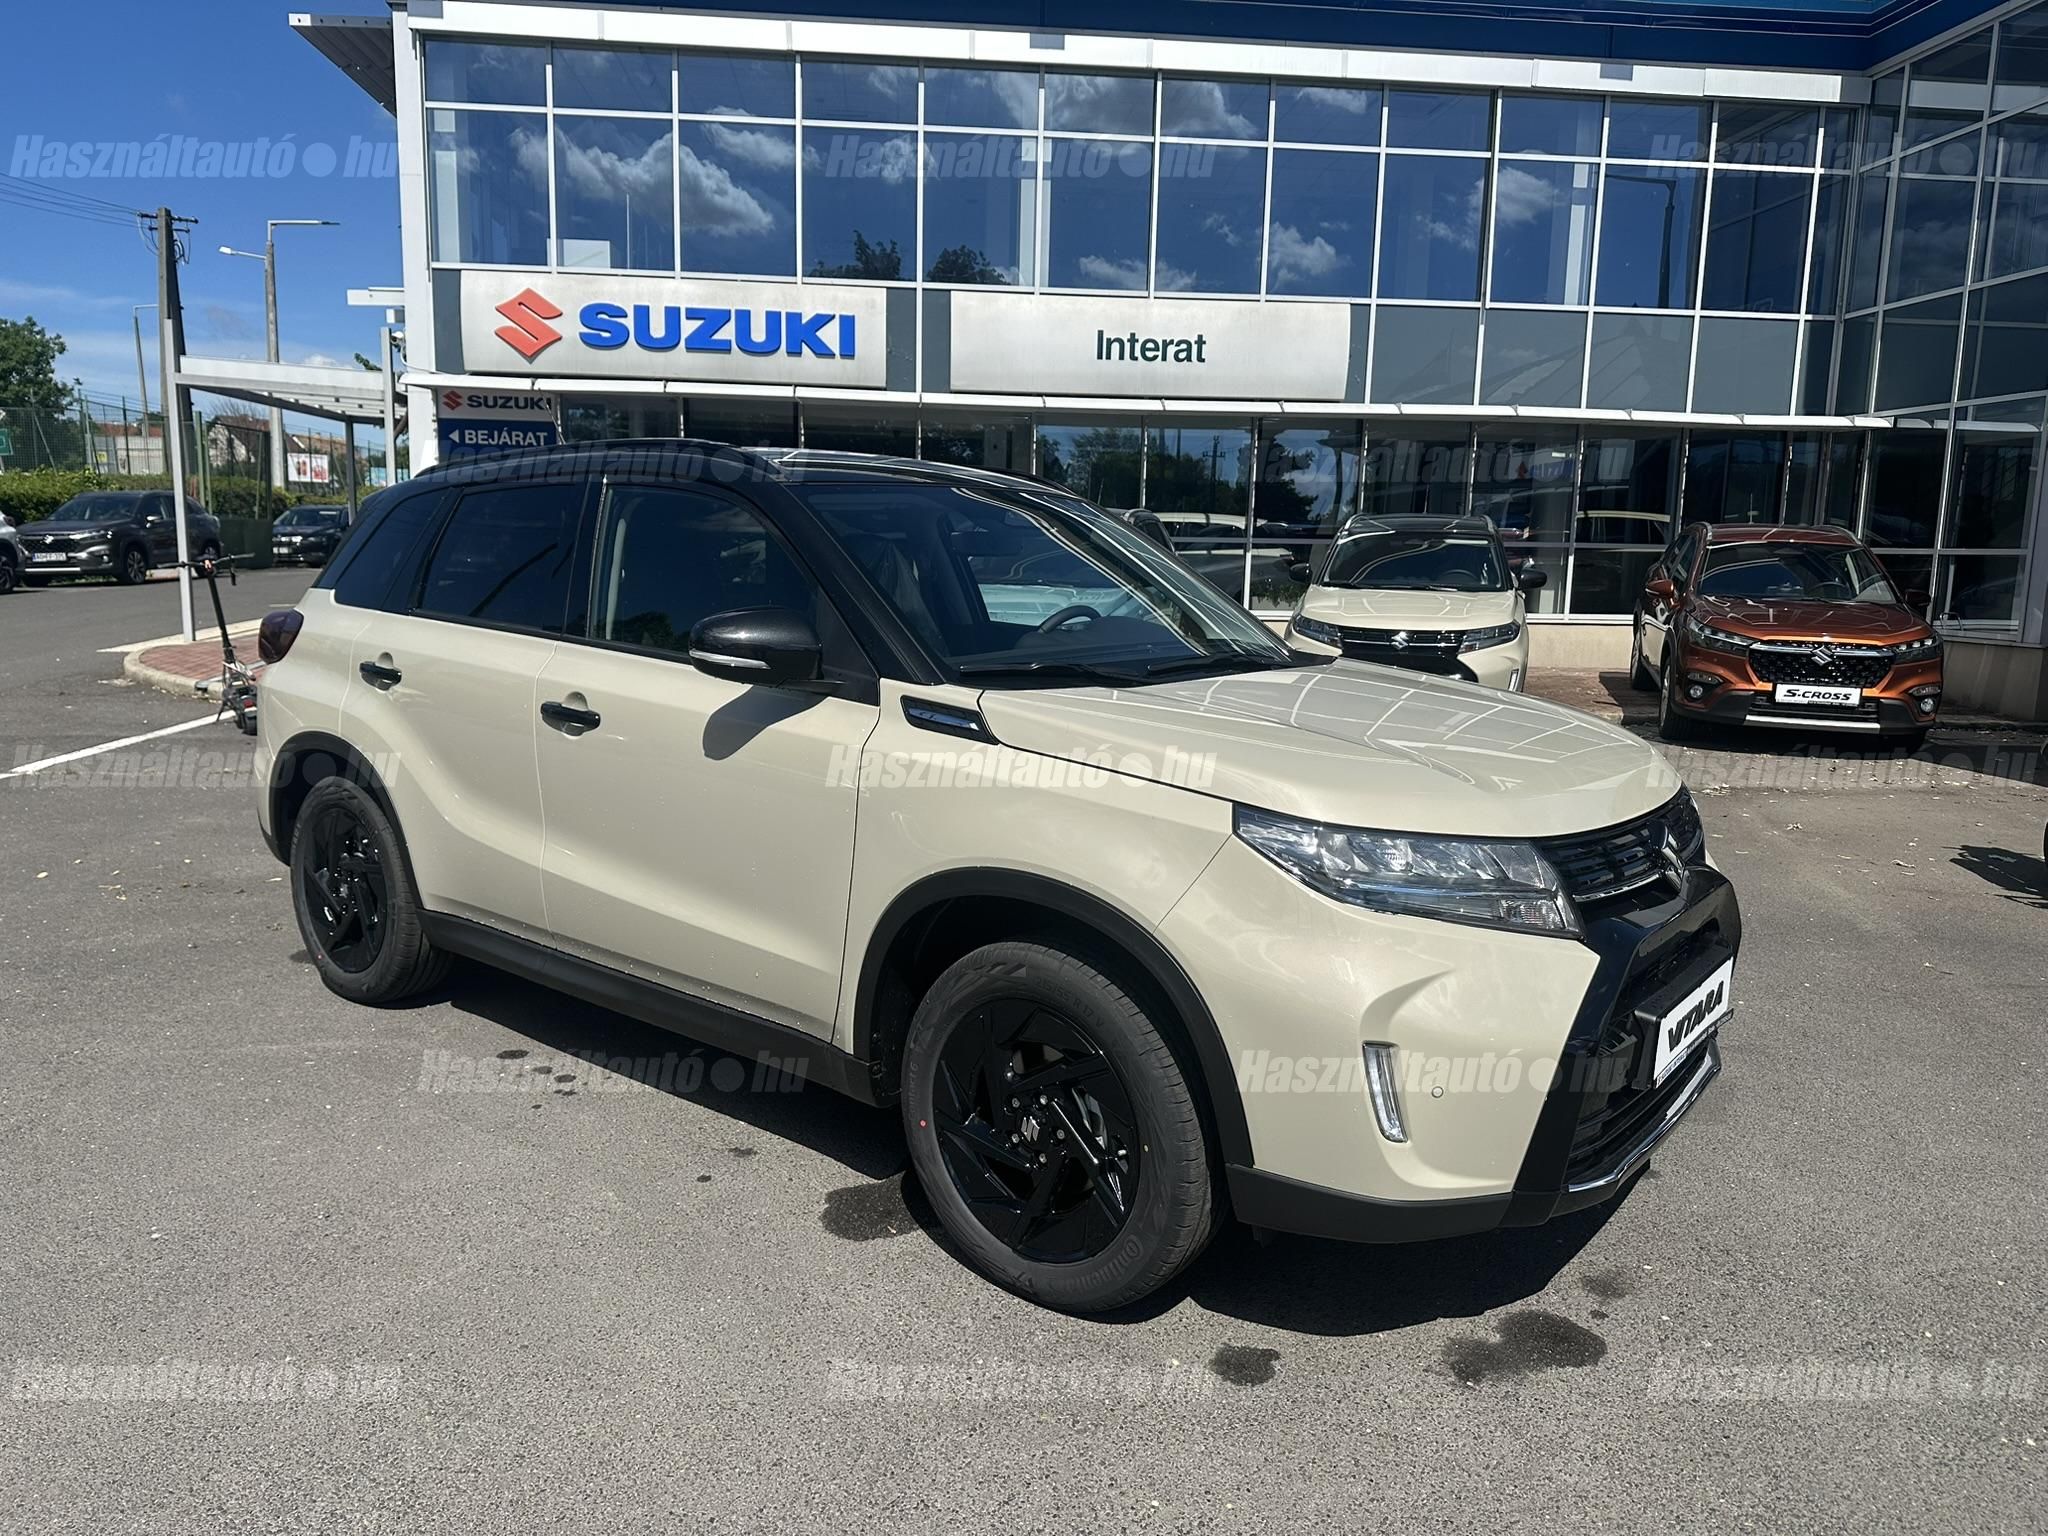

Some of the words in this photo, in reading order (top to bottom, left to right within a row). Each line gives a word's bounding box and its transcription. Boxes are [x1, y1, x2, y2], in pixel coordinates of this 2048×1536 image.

[578, 302, 856, 359] SUZUKI
[1096, 329, 1207, 364] Interat
[467, 394, 552, 411] SUZUKI
[464, 427, 548, 446] BEJÁRAT
[1668, 980, 1724, 1054] VITARA
